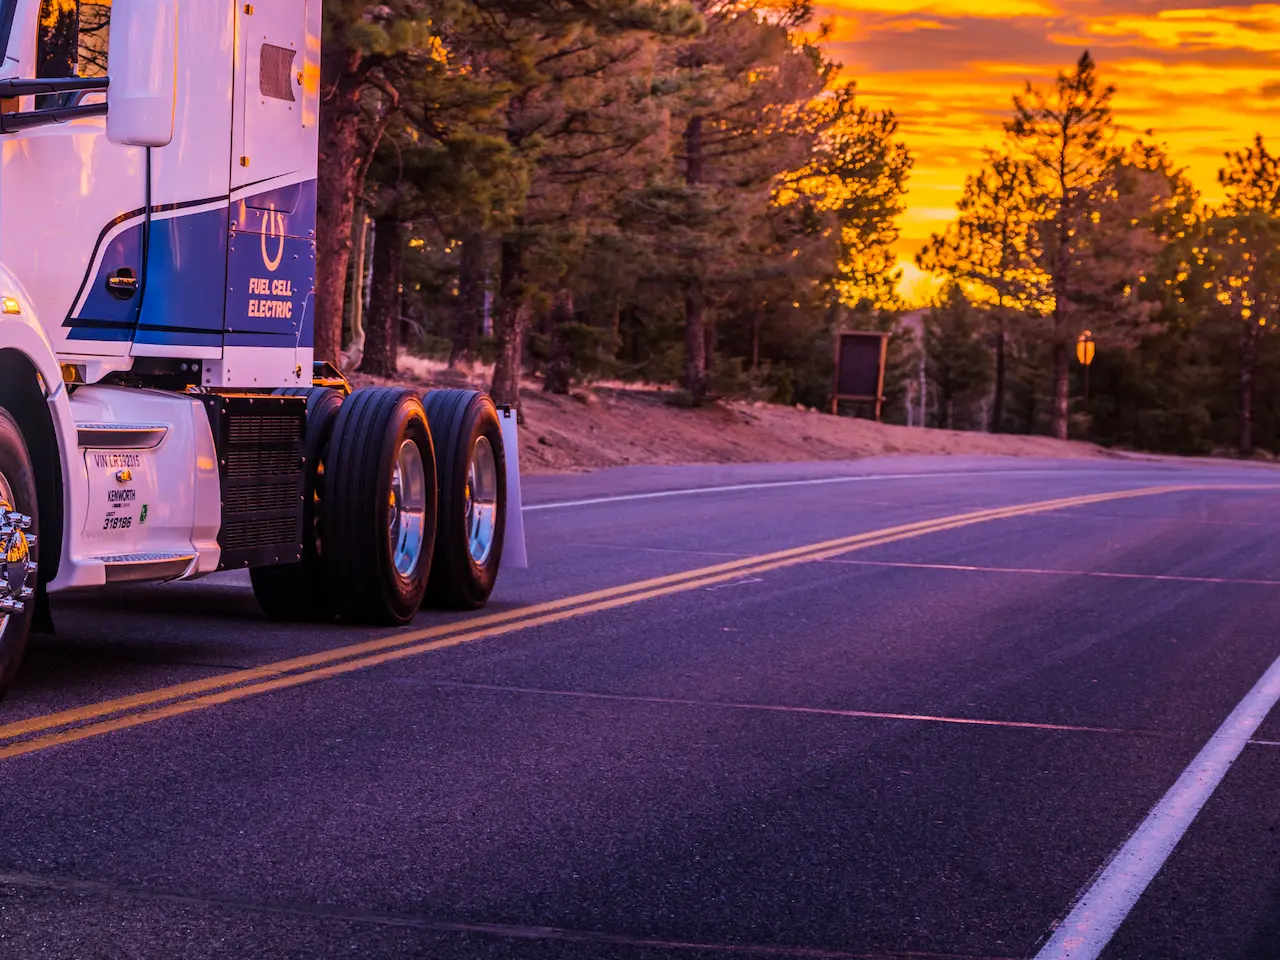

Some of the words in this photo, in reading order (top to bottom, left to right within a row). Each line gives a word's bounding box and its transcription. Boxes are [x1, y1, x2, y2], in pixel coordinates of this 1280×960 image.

[248, 278, 270, 295] FUEL
[272, 279, 292, 296] CELL
[248, 300, 292, 319] ELECTRIC
[94, 454, 108, 468] VIN
[107, 489, 136, 502] KENWORTH
[103, 516, 133, 530] 318186
